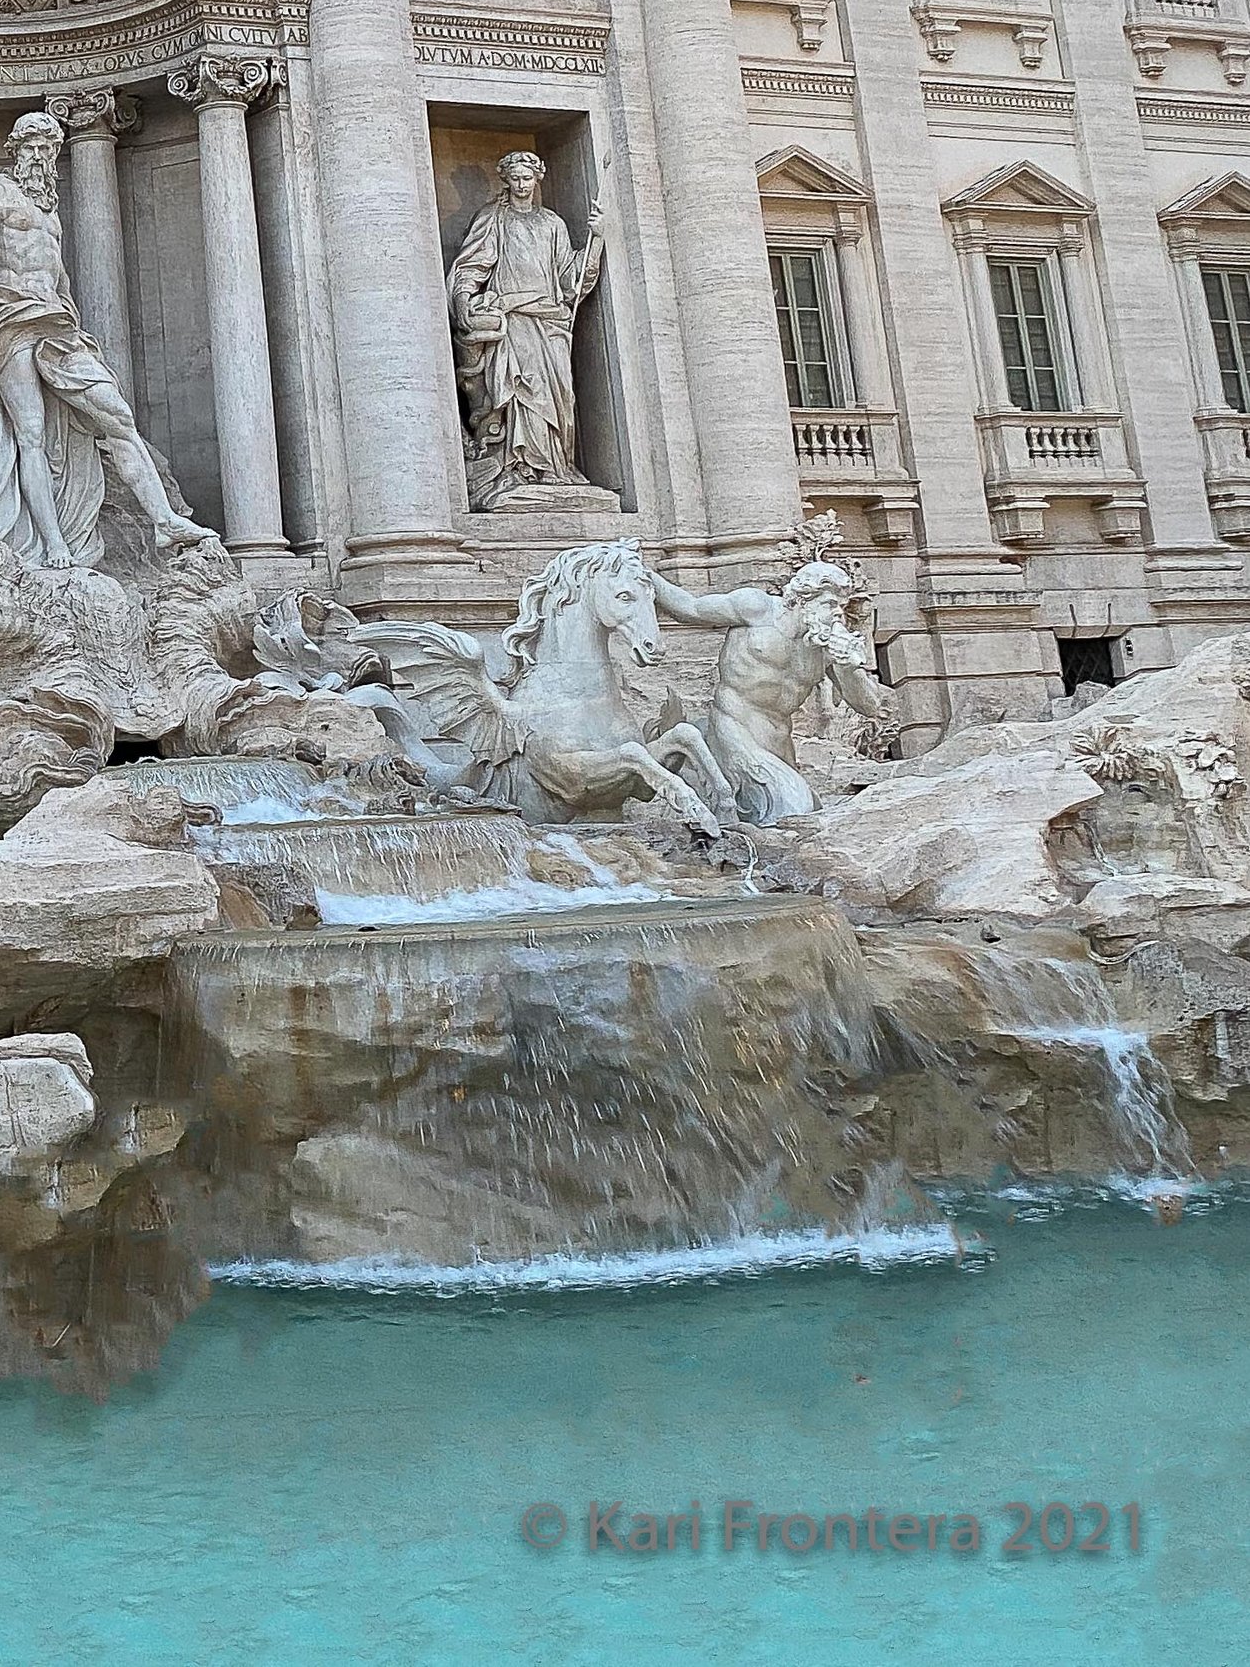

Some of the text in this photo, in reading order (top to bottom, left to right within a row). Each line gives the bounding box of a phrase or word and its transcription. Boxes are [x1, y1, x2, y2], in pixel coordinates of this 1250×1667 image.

[104, 50, 144, 71] OPVS
[152, 37, 184, 59] CVM
[287, 28, 308, 43] AB
